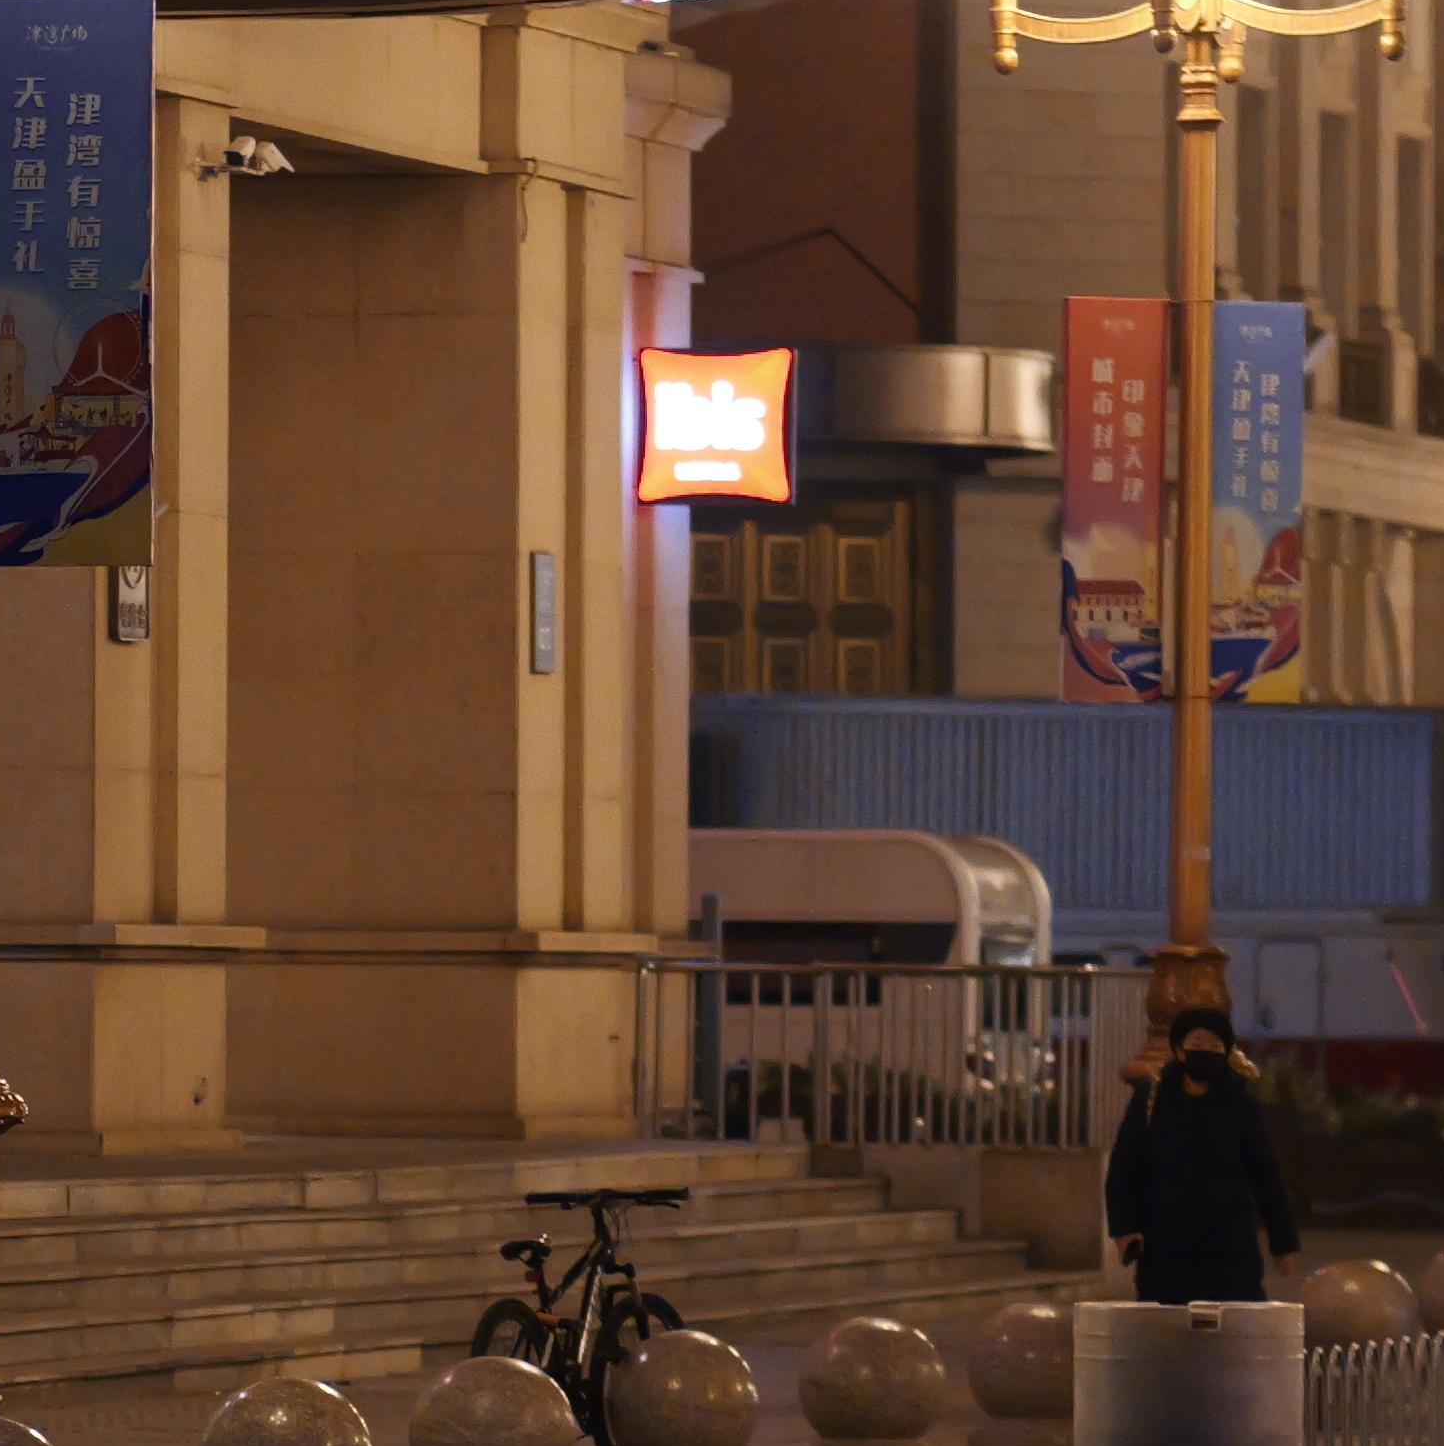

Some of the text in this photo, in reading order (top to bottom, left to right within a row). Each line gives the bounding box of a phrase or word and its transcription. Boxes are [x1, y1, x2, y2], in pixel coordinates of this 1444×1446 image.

[12, 76, 48, 273] 天津盈手礼
[65, 91, 104, 291] 津湾有惊喜
